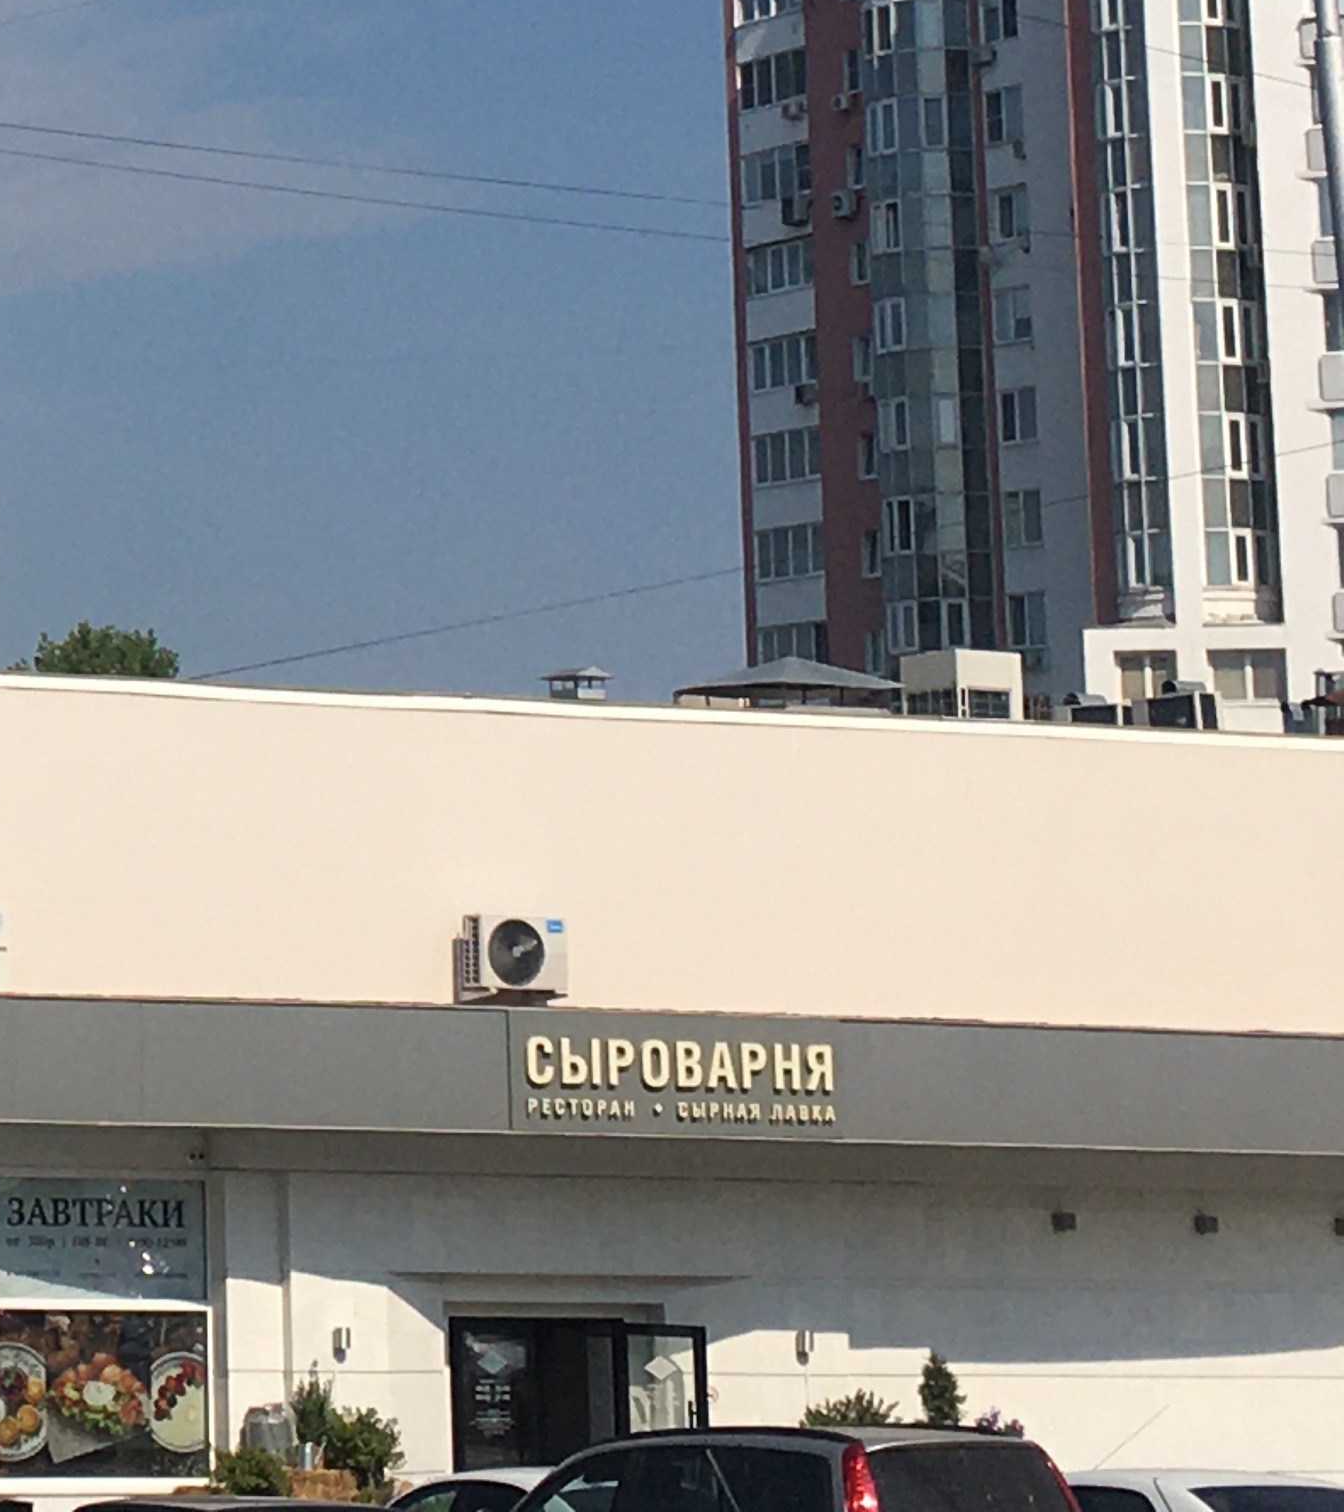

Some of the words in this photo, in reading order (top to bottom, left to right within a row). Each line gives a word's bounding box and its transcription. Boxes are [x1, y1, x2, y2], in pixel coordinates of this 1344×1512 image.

[525, 1035, 836, 1093] СЫРОВАРНЯ
[526, 1097, 635, 1118] РЕСТОРАН
[676, 1101, 761, 1121] СЫРНАЯ
[769, 1103, 837, 1123] ЛАВКА
[6, 1196, 186, 1229] ЗАВТРАКИ
